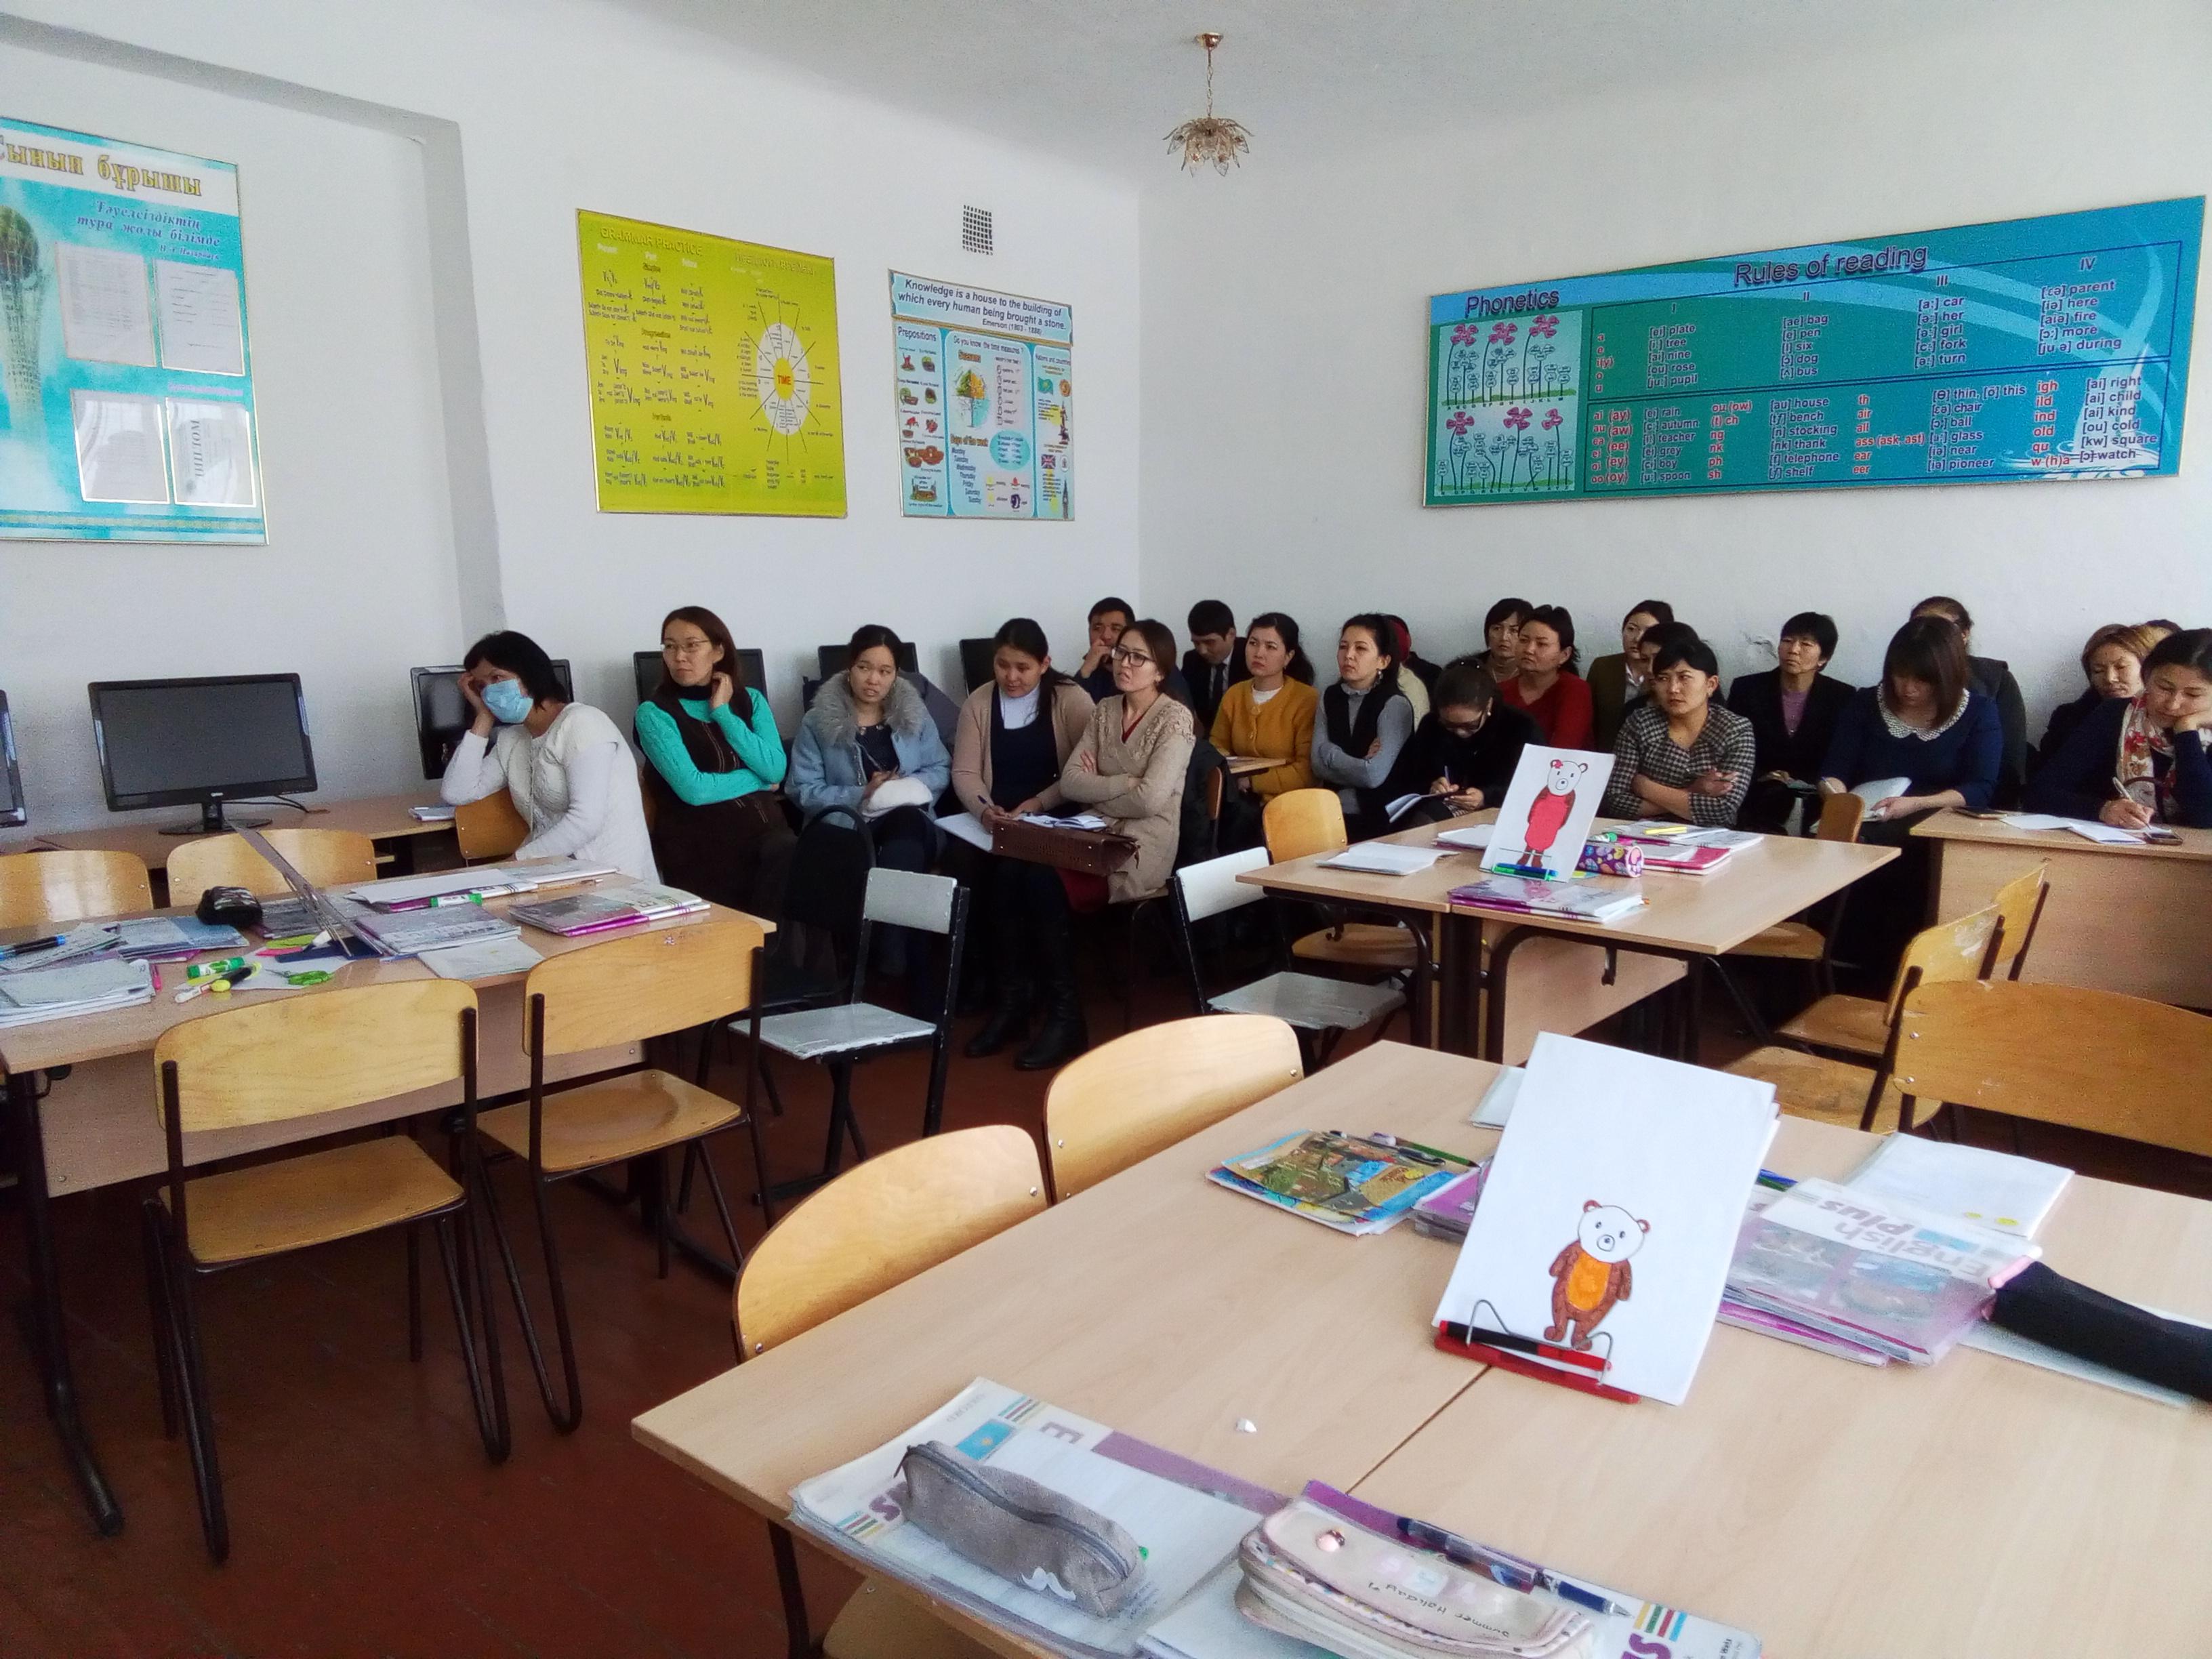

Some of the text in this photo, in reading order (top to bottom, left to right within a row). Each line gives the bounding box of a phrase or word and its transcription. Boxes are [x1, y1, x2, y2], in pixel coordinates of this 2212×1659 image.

[0, 135, 202, 197] ынып бұрышы
[1735, 246, 1928, 286] Rules of reading
[2080, 257, 2095, 270] IV
[1937, 275, 1948, 286] III
[2070, 281, 2115, 295] parent
[905, 279, 954, 298] Knowledge
[956, 288, 964, 298] is
[972, 291, 997, 305] house
[1000, 298, 1006, 306] to
[1009, 299, 1021, 309] the
[1023, 301, 1052, 317] building
[1803, 291, 1809, 301] II
[1465, 289, 1559, 316] Phonetics
[1943, 297, 1964, 307] car
[2068, 298, 2098, 308] here
[898, 293, 924, 304] which
[927, 298, 950, 311] every
[953, 300, 981, 314] human
[983, 306, 1004, 321] being
[1007, 311, 1036, 325] brought
[1807, 315, 1828, 325] bag
[1942, 311, 1963, 321] her
[2074, 311, 2097, 321] fire
[983, 319, 1008, 329] Emerson
[1669, 325, 1696, 336] plate
[1800, 329, 1821, 339] pen
[1941, 325, 1963, 337] girl
[2062, 326, 2097, 337] more
[1666, 338, 1687, 348] tree
[1796, 342, 1813, 351] six
[1940, 339, 1966, 349] fork
[2076, 338, 2122, 350] during
[1668, 350, 1692, 360] nine
[1797, 354, 1818, 364] dog
[1940, 354, 1965, 364] turn
[1671, 363, 1695, 372] rose
[1797, 367, 1818, 376] bus
[777, 375, 792, 386] TIME
[1671, 374, 1698, 386] pupil
[2087, 376, 2142, 391] [ai] right
[2003, 386, 2026, 395] this
[2038, 381, 2057, 393] igh
[1795, 398, 1829, 407] house
[1859, 394, 1869, 405] th
[2036, 396, 2052, 406] ild
[2086, 390, 2141, 405] [ai] child
[1662, 408, 1681, 417] rain
[1954, 403, 1982, 412] chair
[2084, 405, 2136, 419] [ai] kind
[1609, 409, 1631, 422] (ay)
[1725, 416, 1738, 425] ch
[1790, 412, 1824, 422] bench
[2035, 411, 2055, 421] ind
[1662, 419, 1699, 429] autumn
[1951, 416, 1971, 426] ball
[1789, 425, 1837, 436] stocking
[2034, 426, 2054, 436] old
[2083, 419, 2139, 434] [ou] cold
[1659, 432, 1695, 442] teacher
[1711, 431, 1724, 441] ng
[1856, 438, 1875, 446] ass
[1905, 433, 1925, 446] ast)
[1951, 431, 1983, 443] glass
[2112, 435, 2157, 447] square
[1607, 441, 1629, 452] (ee)
[1710, 443, 1723, 453] nk
[1795, 439, 1826, 449] thank
[2032, 443, 2049, 453] qu
[1660, 448, 1681, 457] grey
[1854, 451, 1871, 460] ear
[1950, 446, 1976, 455] near
[2098, 449, 2136, 460] watch
[1708, 457, 1722, 467] ph
[1784, 453, 1839, 464] telephone
[1660, 459, 1677, 469] boy
[1949, 458, 1994, 470] pioneer
[1708, 470, 1721, 479] sh
[1786, 466, 1814, 477] shelf
[1853, 466, 1870, 474] eer
[1660, 472, 1690, 482] spoon
[1834, 1222, 1991, 1277] English
